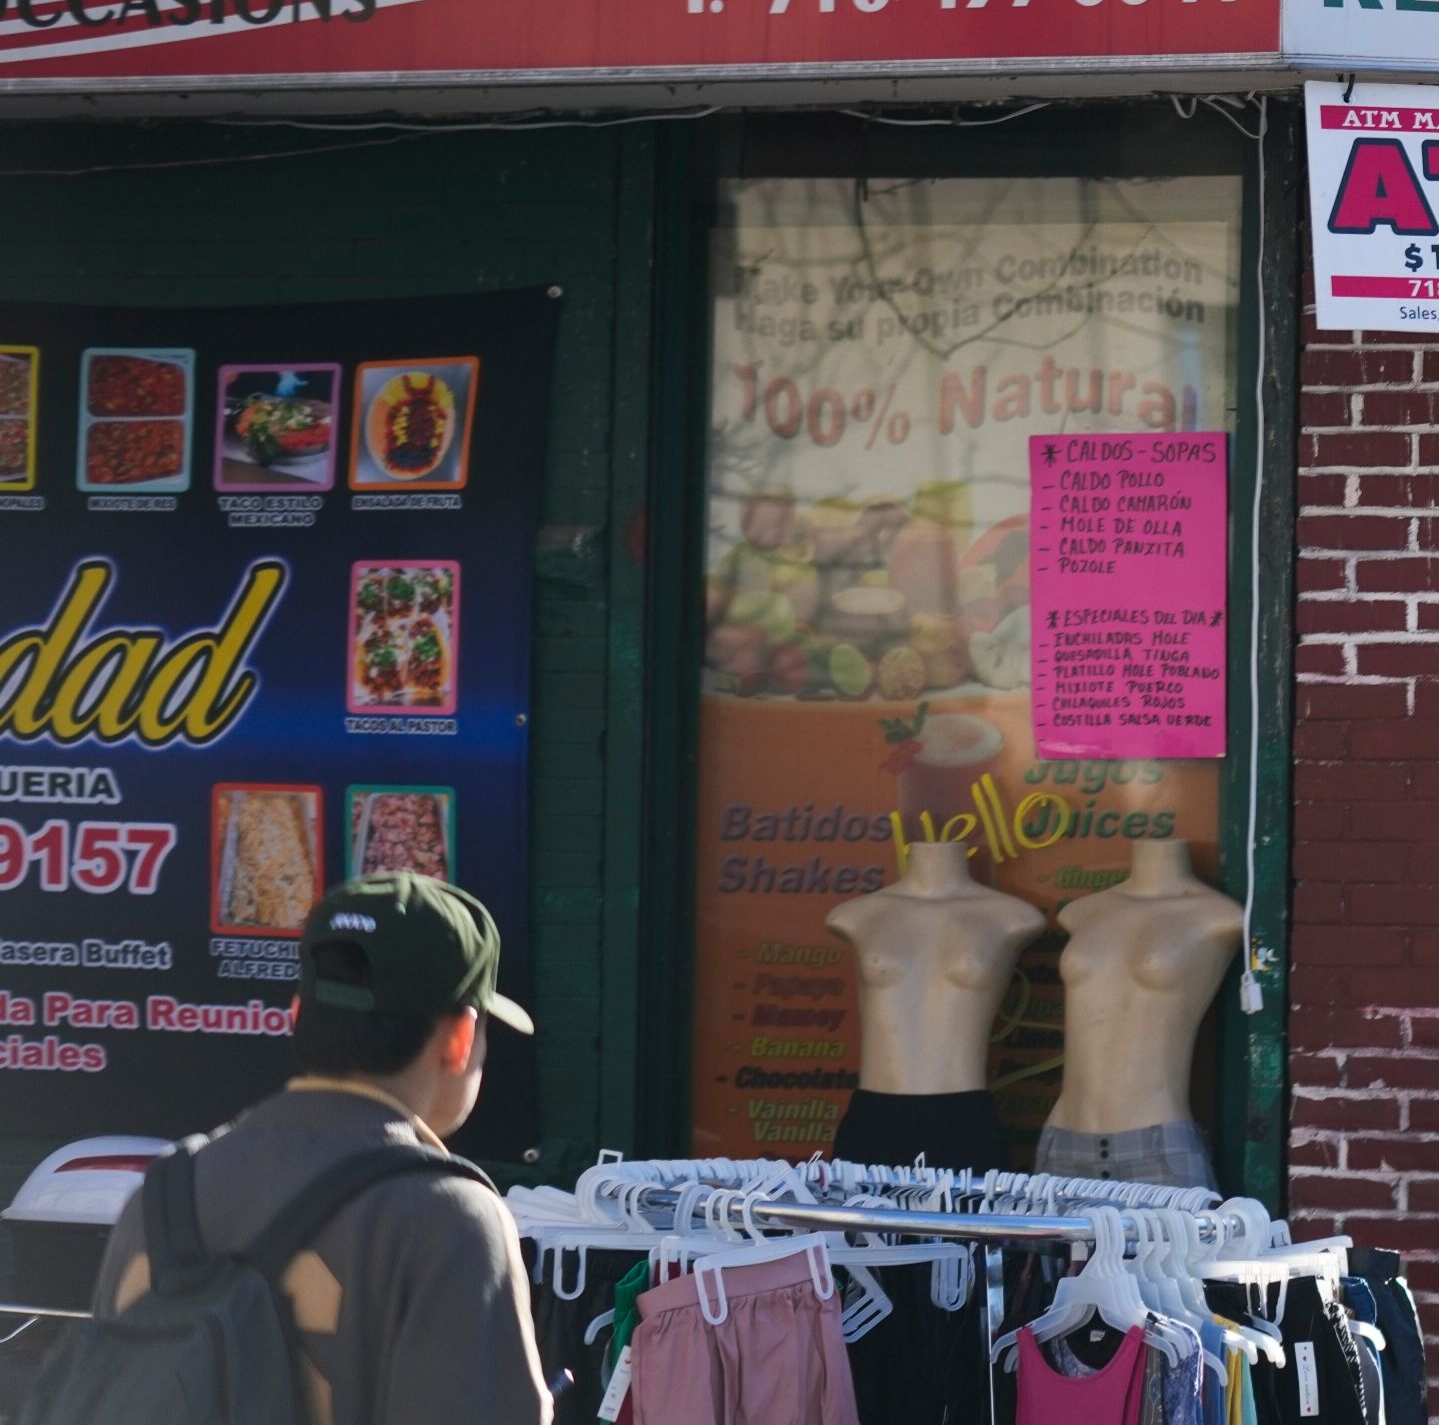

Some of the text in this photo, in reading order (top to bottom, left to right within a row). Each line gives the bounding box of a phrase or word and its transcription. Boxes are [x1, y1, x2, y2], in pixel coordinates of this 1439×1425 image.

[1342, 110, 1402, 130] ATM
[733, 355, 1198, 451] 100% Natural
[1067, 439, 1217, 463] CALDOS SOPAS
[1060, 470, 1164, 490] CALDO POLLO
[720, 804, 891, 843] Batidos
[717, 858, 885, 894] Shakes
[83, 940, 171, 968] Buffet
[46, 993, 293, 1033] Para Reunio
